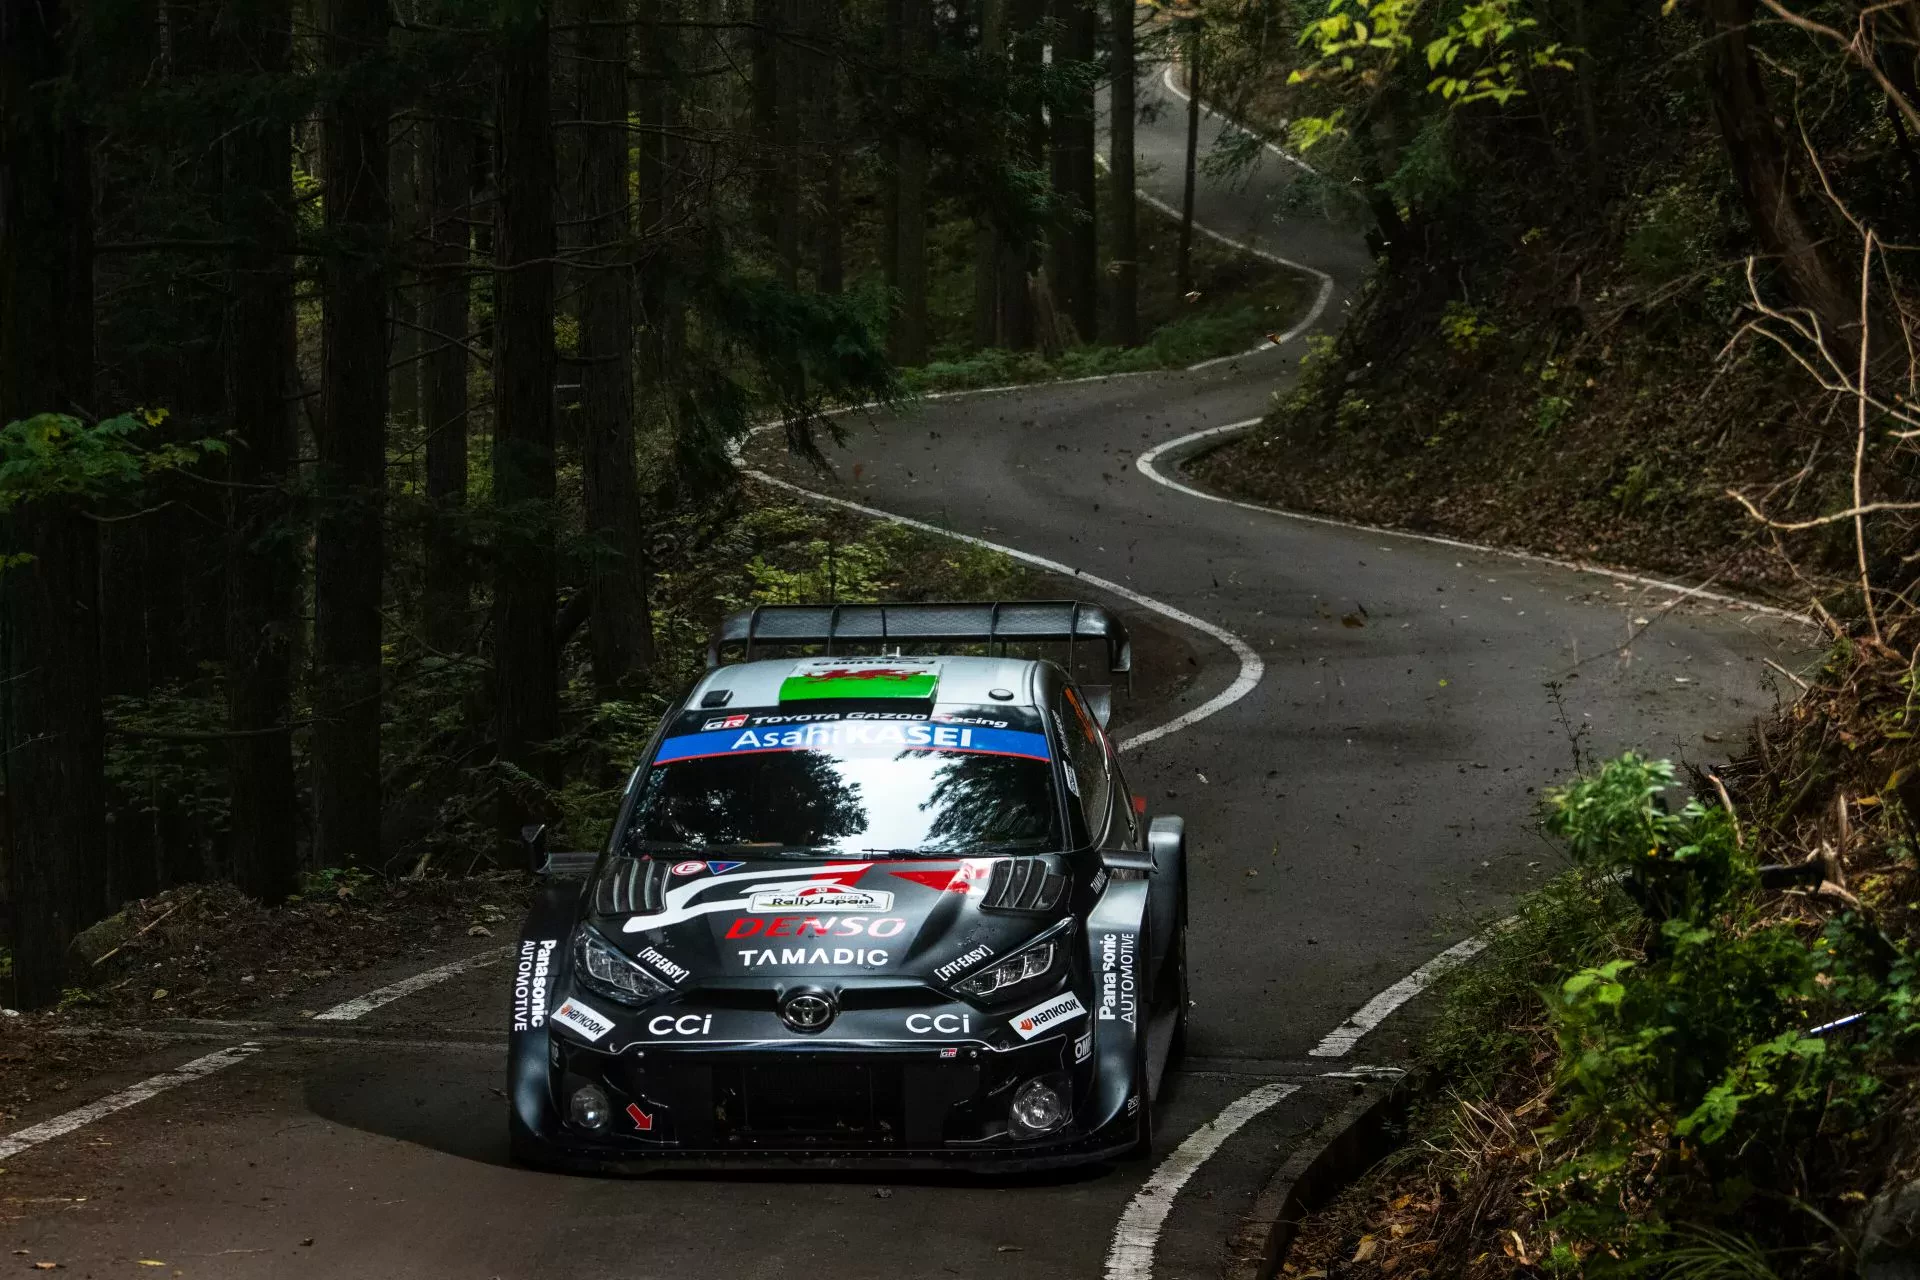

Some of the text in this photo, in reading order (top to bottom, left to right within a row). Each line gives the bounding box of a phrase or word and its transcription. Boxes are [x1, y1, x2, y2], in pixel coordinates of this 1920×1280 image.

[703, 716, 746, 731] GR
[752, 713, 840, 725] TOYOTA
[846, 711, 928, 721] GAZOO
[724, 916, 907, 940] DENSO
[738, 948, 889, 966] TAMADIC
[514, 940, 537, 1032] AUTOMOTIVE
[531, 939, 557, 1028] Panasonic
[1099, 933, 1117, 1020] Panasonic
[1120, 933, 1134, 1024] AUTOMOTIVE
